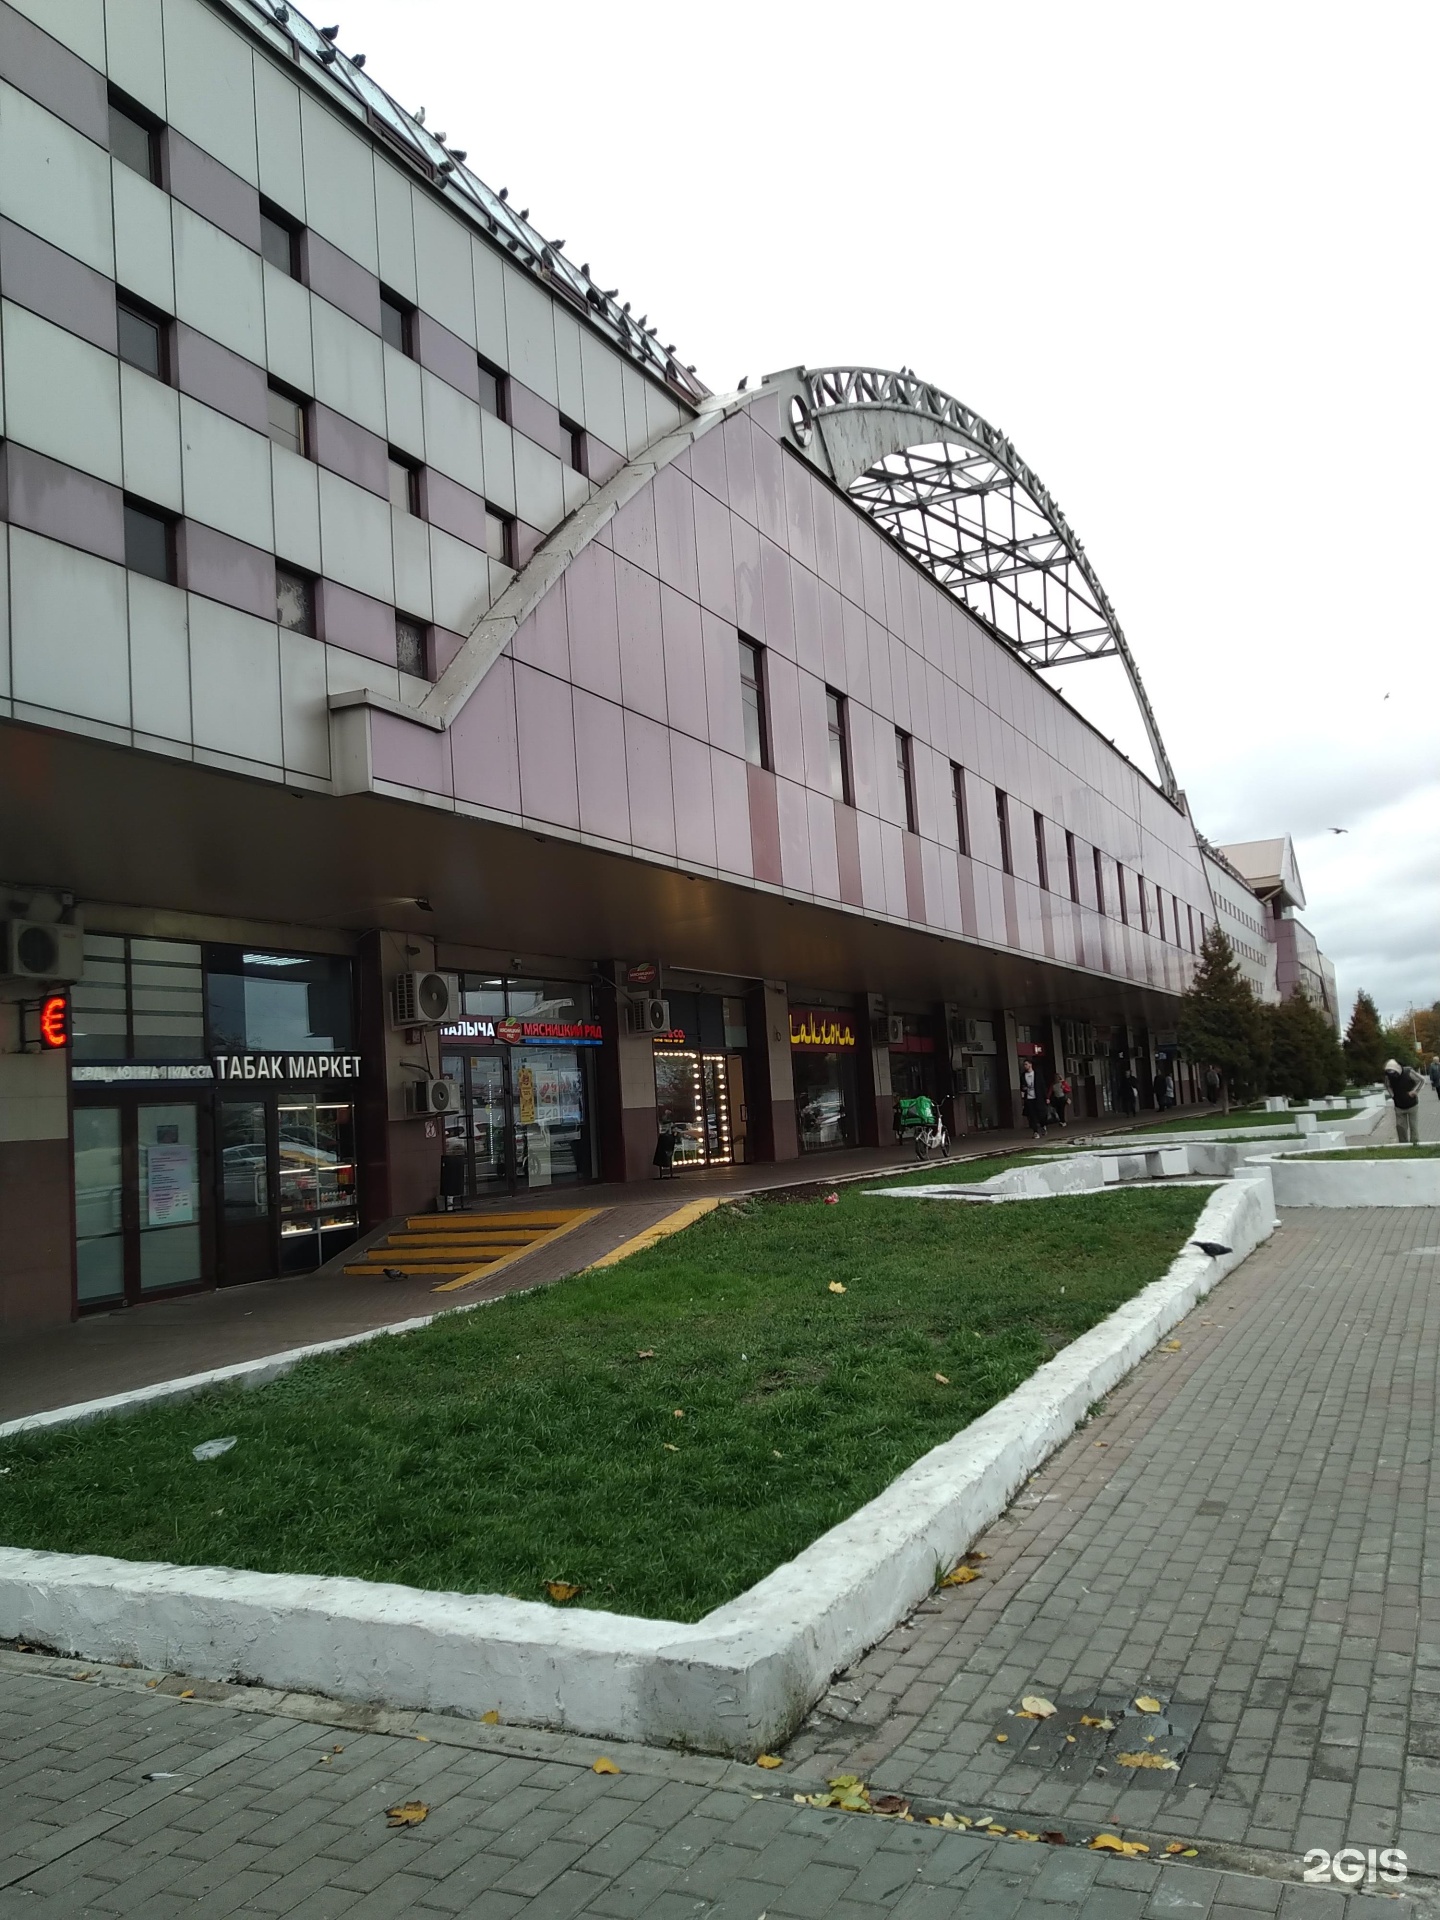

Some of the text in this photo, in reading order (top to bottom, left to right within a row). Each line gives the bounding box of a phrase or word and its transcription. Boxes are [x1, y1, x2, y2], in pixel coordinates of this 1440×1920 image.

[523, 1021, 603, 1039] МЯСНИЦКИЙ РЯД
[168, 1065, 214, 1080] КАССА
[215, 1055, 362, 1080] ТАБАК МАРКЕТ
